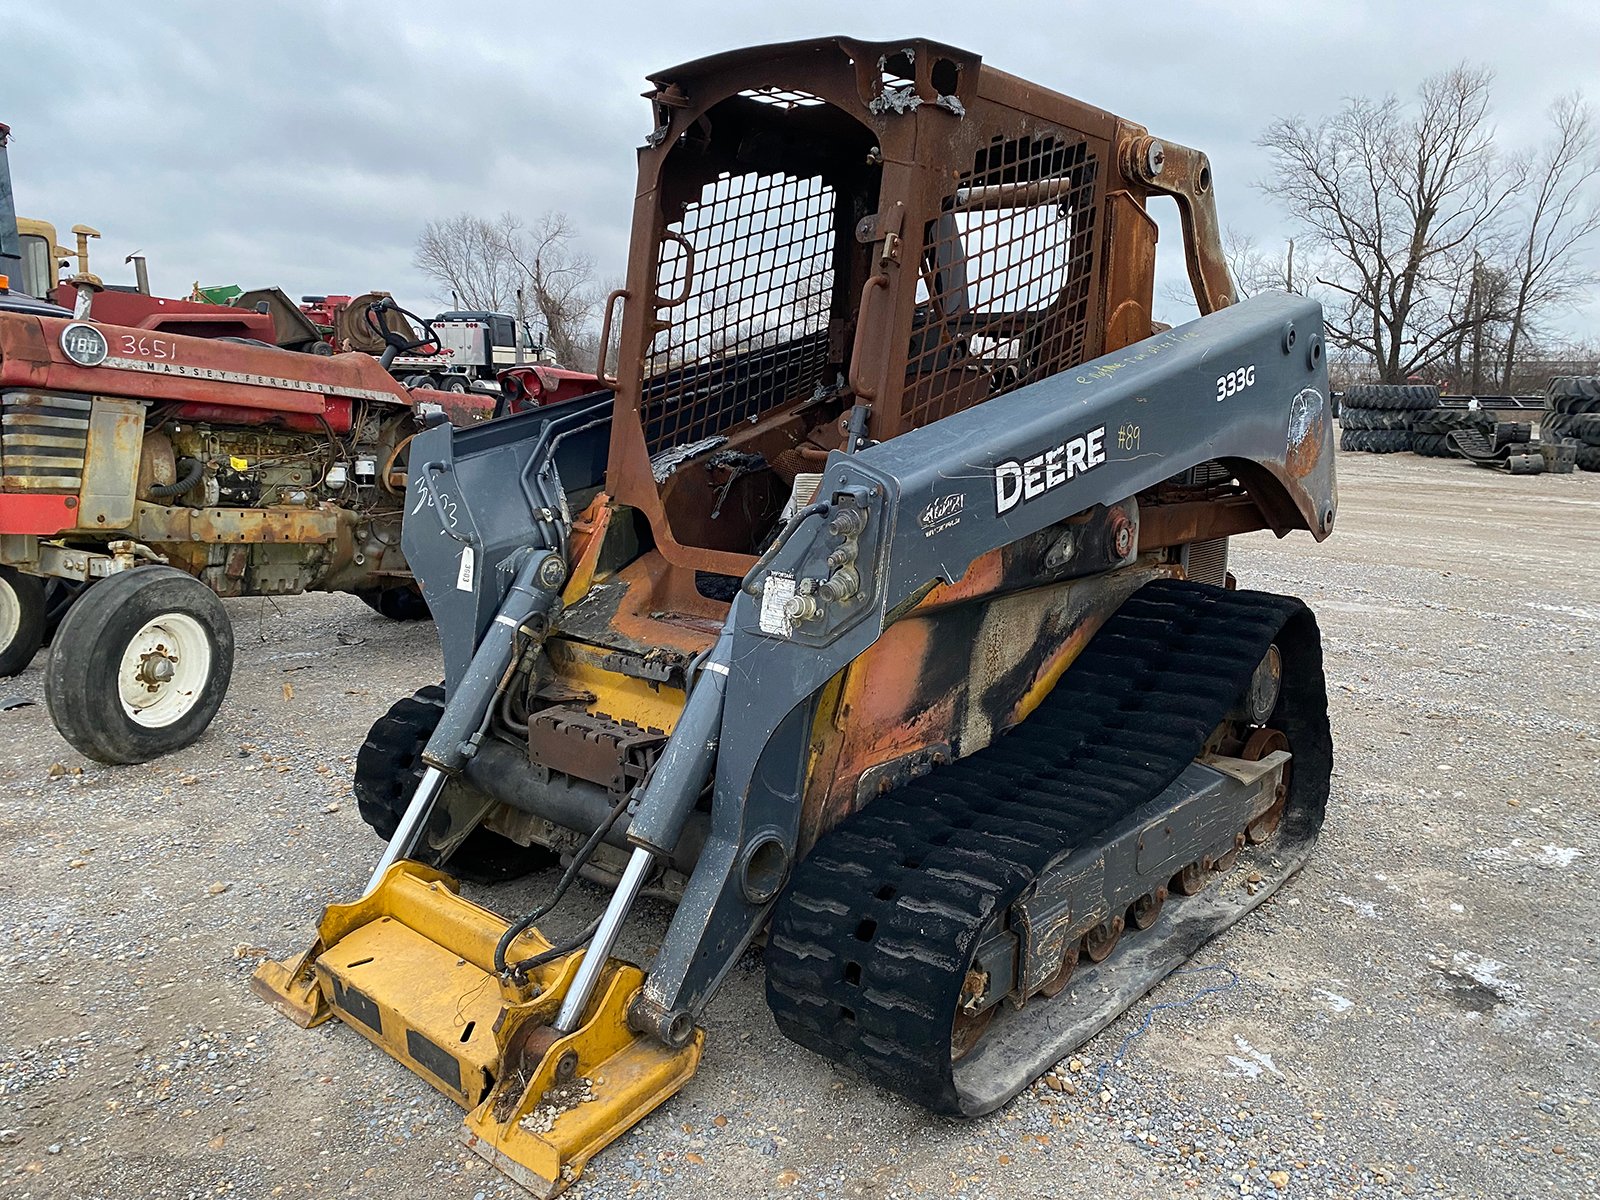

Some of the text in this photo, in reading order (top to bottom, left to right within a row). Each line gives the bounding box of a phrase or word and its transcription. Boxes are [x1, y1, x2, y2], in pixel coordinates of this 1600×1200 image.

[69, 336, 98, 355] 180
[121, 335, 176, 360] 3651
[1216, 364, 1255, 402] 333G
[1117, 423, 1141, 451] #89
[995, 426, 1106, 514] DEERE
